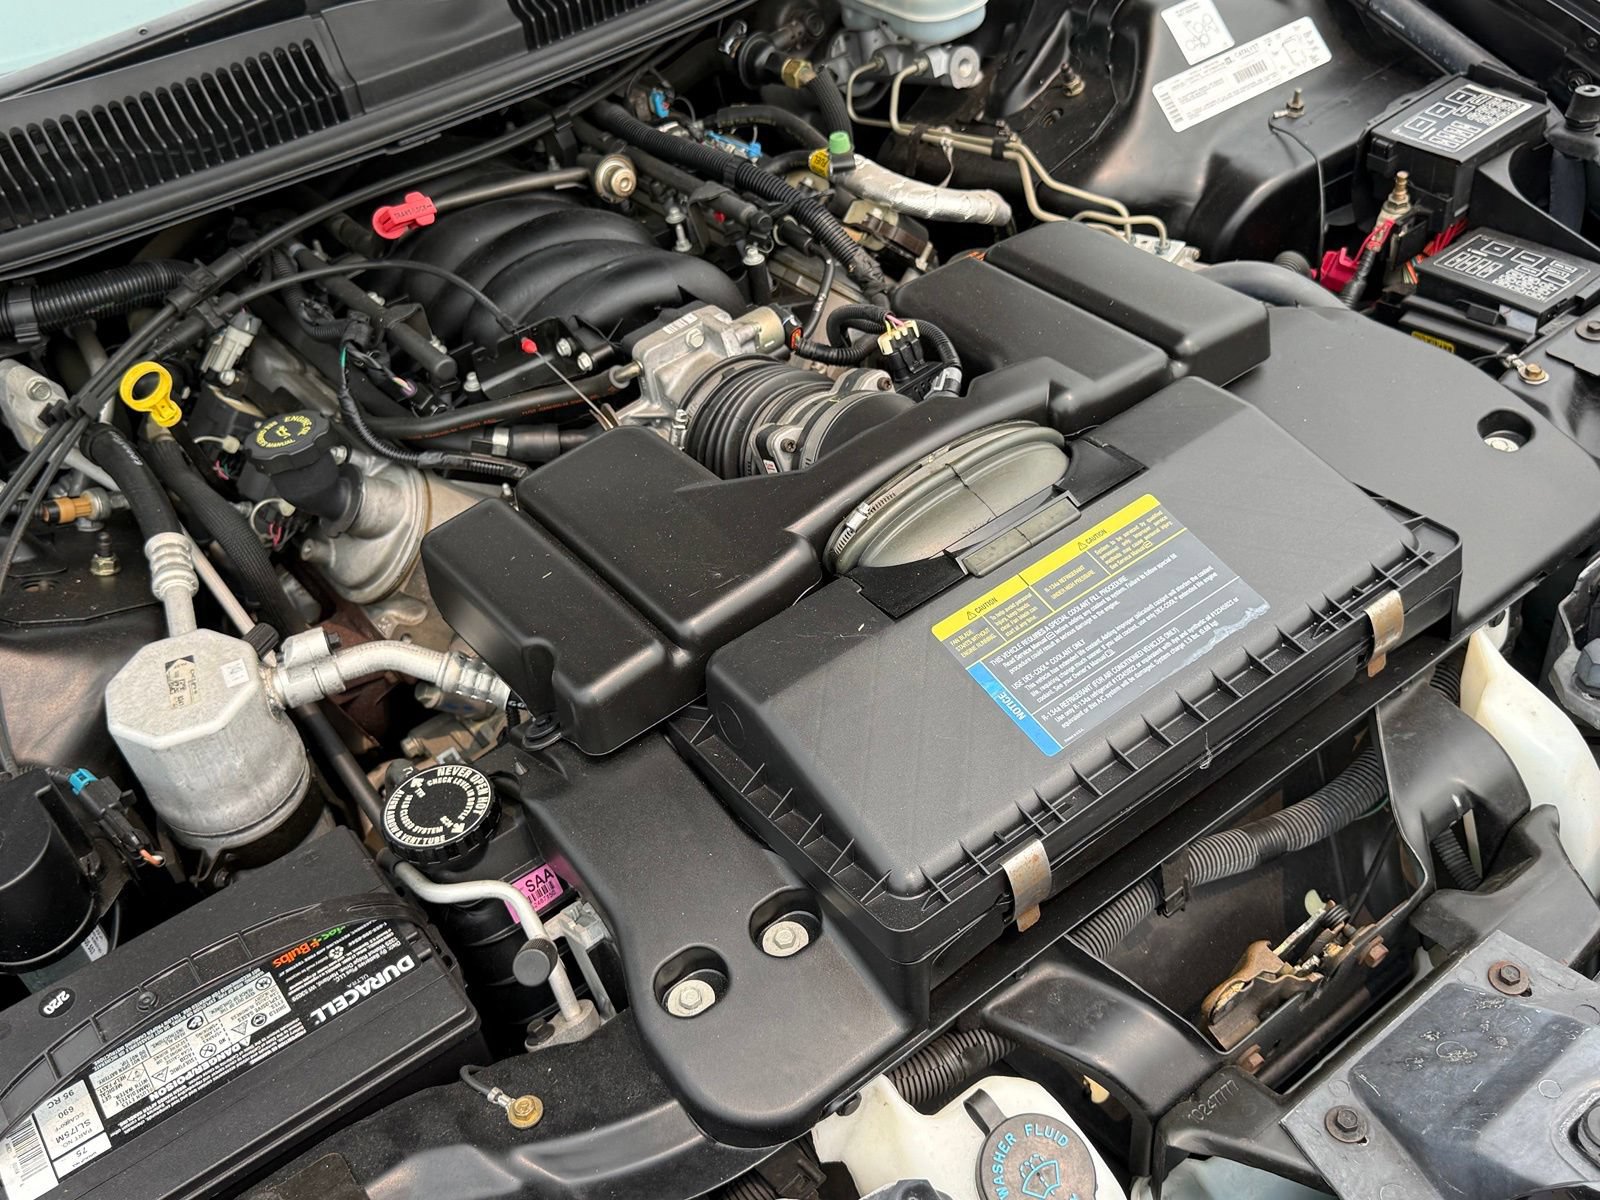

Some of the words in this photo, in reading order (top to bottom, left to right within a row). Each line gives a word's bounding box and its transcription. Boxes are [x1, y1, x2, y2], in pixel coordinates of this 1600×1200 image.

[284, 415, 312, 427] ENGINE
[265, 438, 296, 448] MANUAL
[1084, 528, 1107, 544] CAUTION
[973, 596, 998, 613] CAUTION
[989, 655, 1003, 666] THIS
[1000, 642, 1023, 659] VEHICLE
[1020, 627, 1046, 646] REQUIRES
[1047, 613, 1069, 629] SPECIAL
[1066, 599, 1091, 616] COOLANT
[1088, 592, 1100, 602] FILL
[1098, 575, 1128, 596] PROCEDURE
[1010, 679, 1023, 689] USE
[1048, 646, 1073, 665] COOLANT
[1071, 638, 1086, 650] ONLY
[1040, 705, 1062, 721] R-134a
[1058, 683, 1094, 709] REFRIGERANT
[1091, 675, 1105, 687] (FOR
[1102, 670, 1114, 680] AIR
[1110, 649, 1144, 674] CONDITIONED
[1141, 635, 1166, 653] VEHICLES
[1162, 626, 1179, 639] ONLY)
[998, 691, 1026, 720] NOTICE
[437, 766, 472, 778] NEVER
[427, 777, 453, 786] CHECK
[453, 778, 471, 790] LEVEL
[470, 774, 488, 796] OPEN
[388, 789, 405, 810] ALIGN
[467, 789, 475, 797] IN
[458, 796, 475, 821] BOTTLE
[473, 796, 488, 815] HOT
[387, 811, 400, 833] ARROW
[400, 809, 415, 830] CLOSED
[412, 825, 443, 835] SYSTEM
[395, 830, 403, 838] &
[401, 833, 423, 845] VENT
[422, 835, 446, 845] TUBE
[525, 868, 554, 892] SAA
[271, 940, 310, 971] Bulbs
[379, 947, 387, 956] By
[357, 951, 380, 969] Batteries
[345, 964, 358, 976] Plus
[333, 971, 346, 983] LLC.
[346, 972, 368, 989] ULTRA
[310, 953, 414, 1025] DURACELL
[43, 990, 71, 1016] 2/20
[254, 994, 281, 1012] EXPLOSIVE
[237, 1010, 253, 1022] GASES
[268, 1003, 286, 1017] SHIELD
[129, 1053, 138, 1061] NOT
[130, 1057, 140, 1065] NOT
[140, 1052, 147, 1060] DO
[179, 1052, 191, 1062] ACID
[117, 1062, 130, 1073] OPEN
[149, 1042, 240, 1101] DANGER/POISON
[169, 1057, 194, 1074] SULFURIC
[112, 1074, 126, 1085] HELP
[134, 1077, 148, 1088] WITH
[62, 1088, 74, 1099] 95
[99, 1082, 122, 1098] MEDICAL
[115, 1082, 150, 1105] IMMEDIATELY
[135, 1086, 152, 1099] FLUSH
[46, 1096, 61, 1109] RC
[101, 1094, 111, 1103] GET
[121, 1096, 135, 1107] EYES
[1188, 1080, 1240, 1124] 10247777
[57, 1105, 74, 1119] 690
[74, 1127, 92, 1140] PART
[75, 1146, 87, 1157] 75
[992, 1132, 1017, 1200] WASHER
[1024, 1123, 1069, 1147] FLUID
